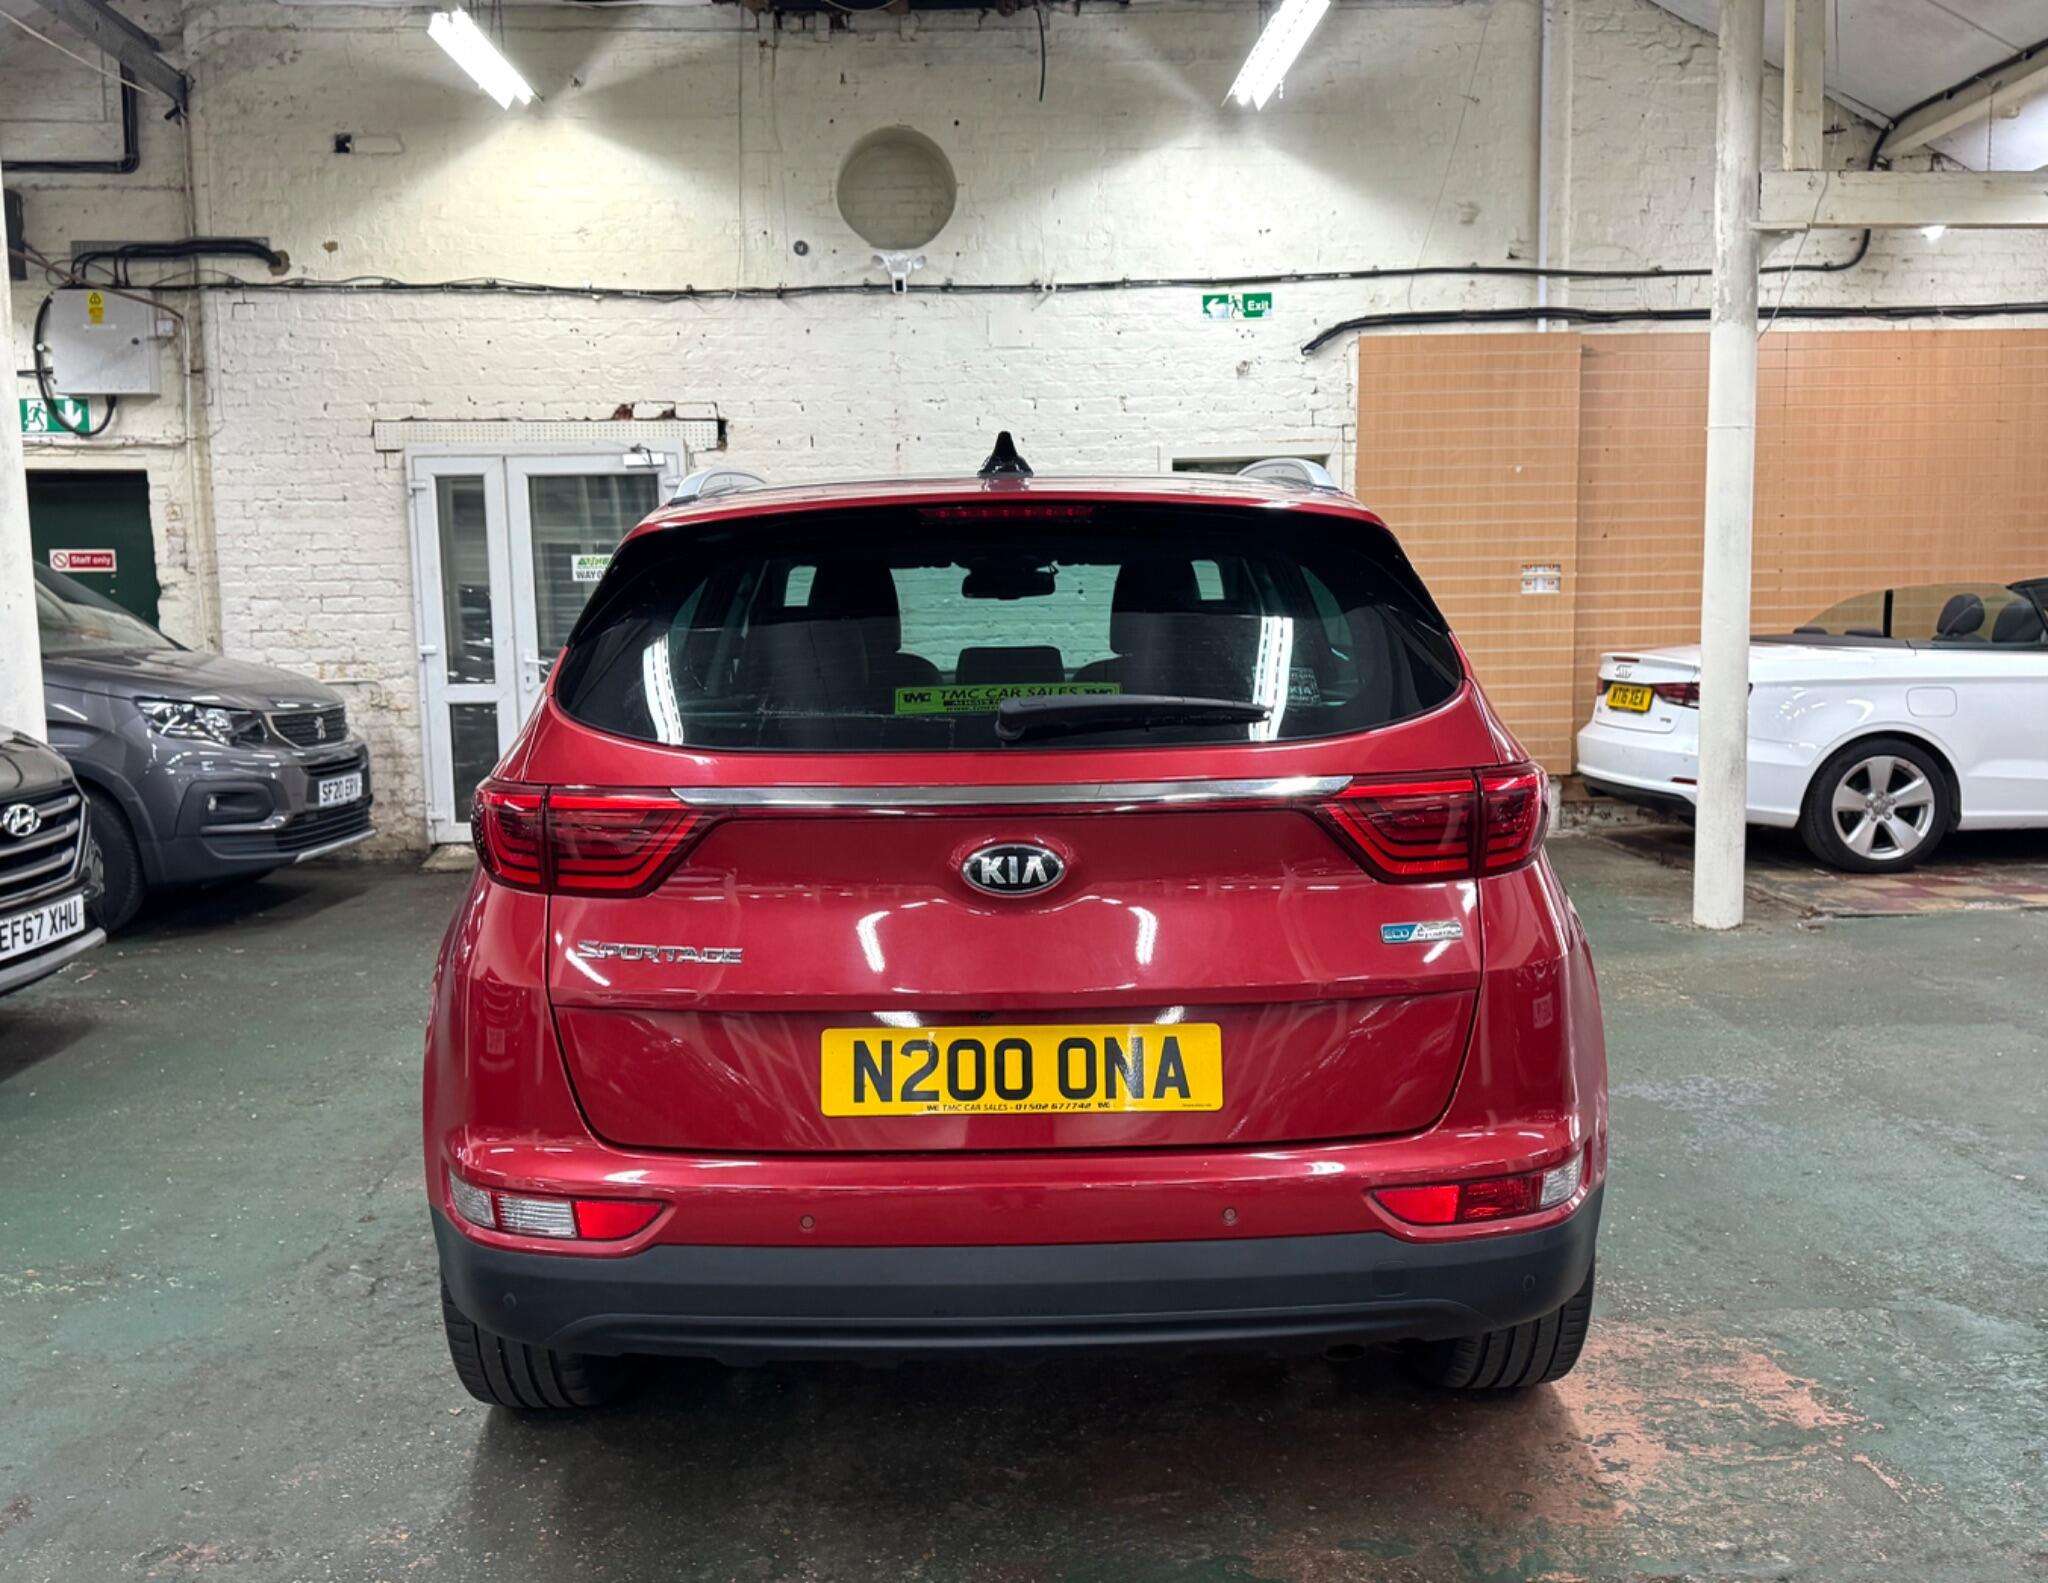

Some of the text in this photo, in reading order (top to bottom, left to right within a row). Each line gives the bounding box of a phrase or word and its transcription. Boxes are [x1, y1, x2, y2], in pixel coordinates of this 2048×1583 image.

[1247, 300, 1269, 311] Exit
[71, 556, 110, 566] Staff only
[941, 686, 1078, 699] TMC CAR SALES
[979, 855, 1050, 885] KIA
[0, 900, 78, 952] EF67 XHU
[577, 940, 743, 964] SPORTAGE
[853, 1035, 1191, 1103] N200 ONA
[984, 1104, 1008, 1112] SALES
